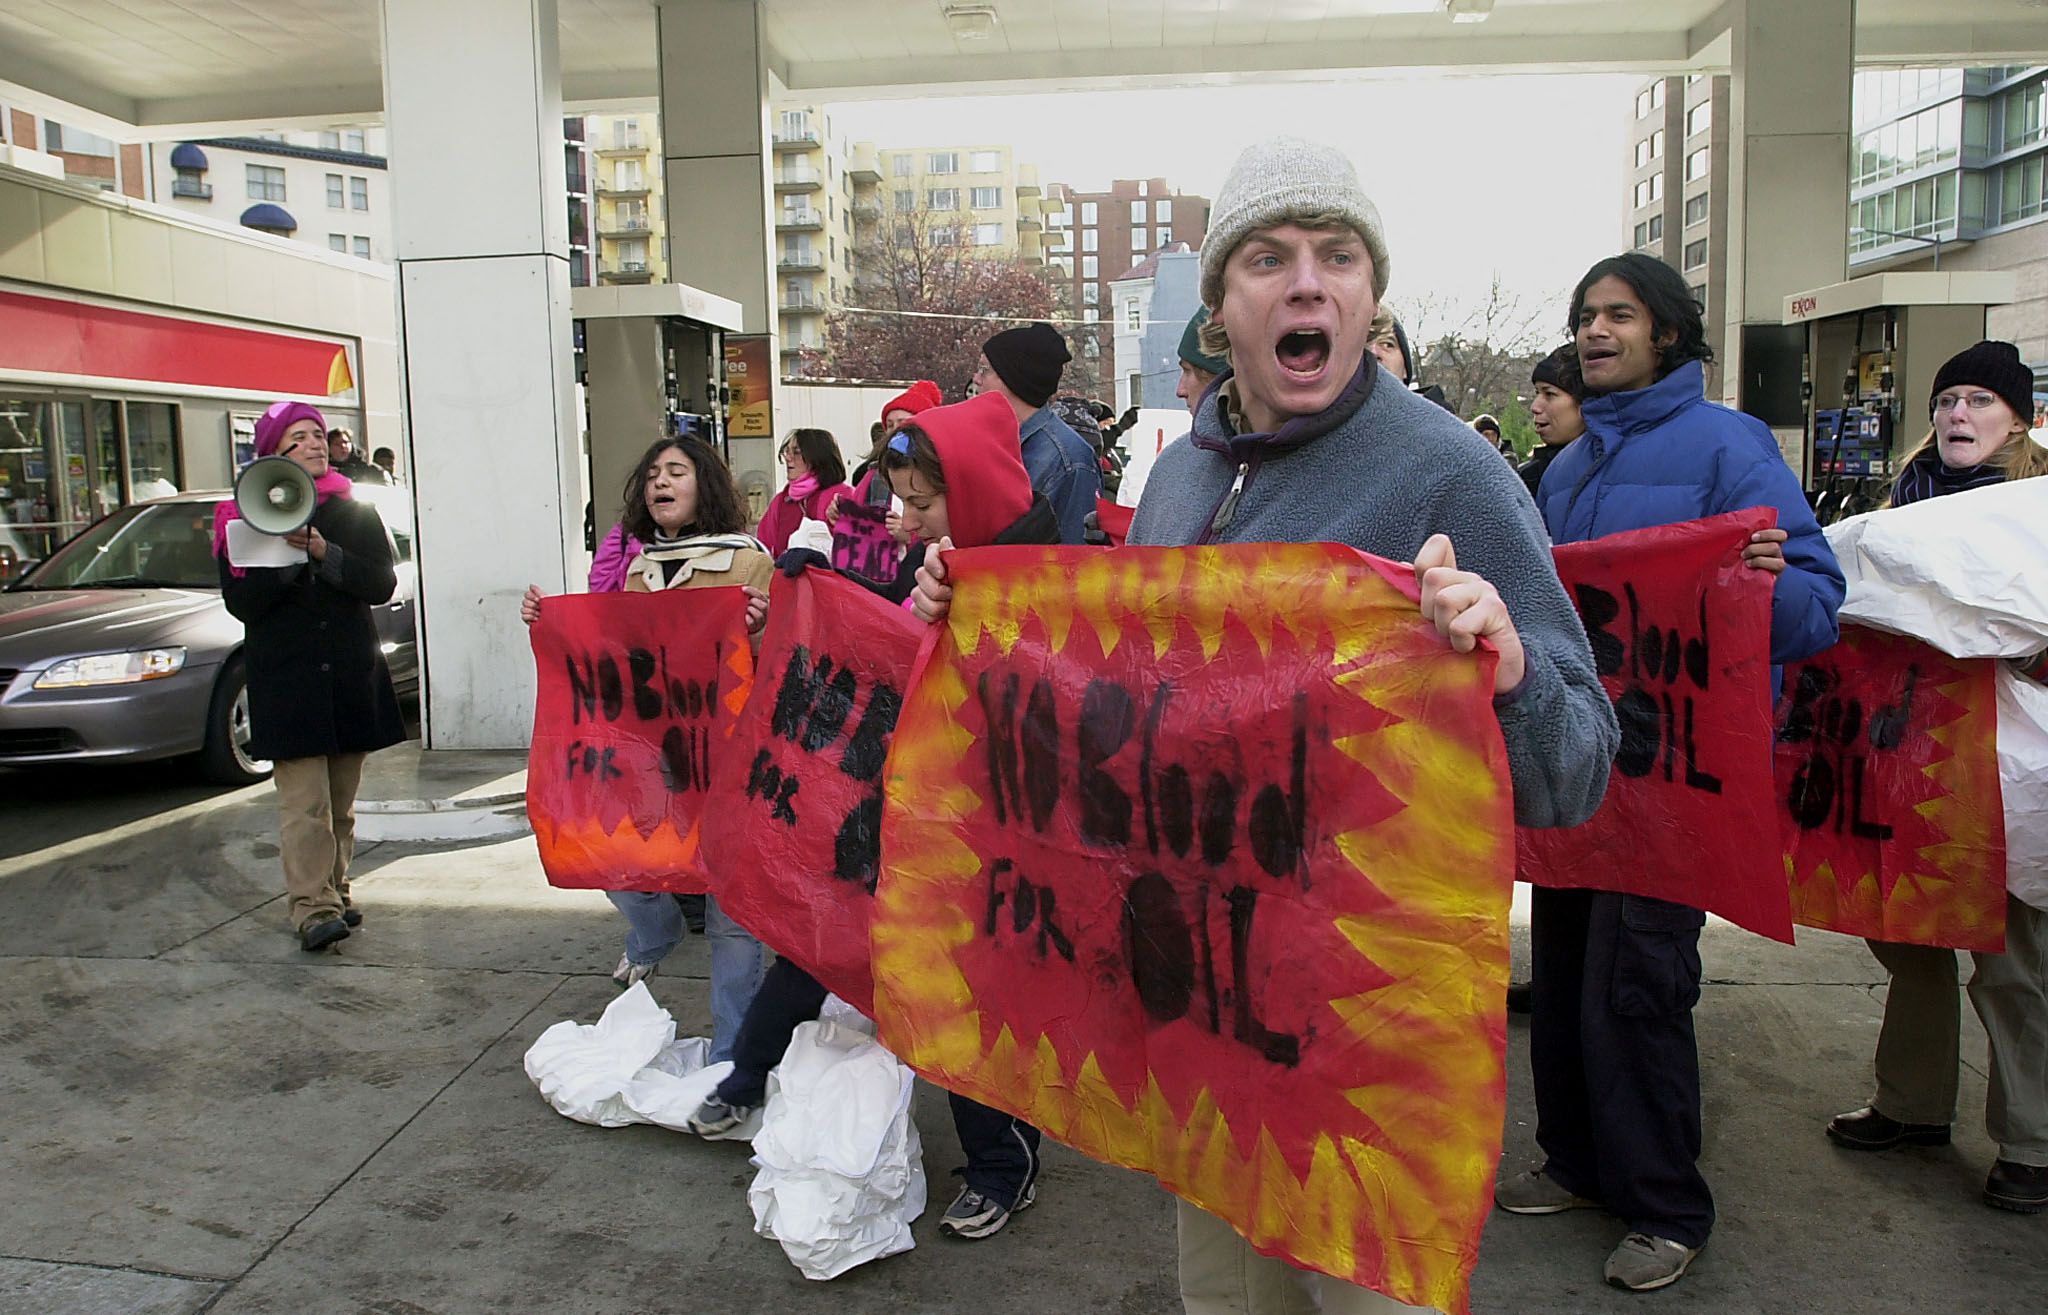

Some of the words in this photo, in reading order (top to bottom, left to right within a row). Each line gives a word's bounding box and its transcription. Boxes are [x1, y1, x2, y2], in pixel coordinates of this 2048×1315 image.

[1791, 296, 1817, 318] EXXON
[565, 647, 624, 725] NO
[628, 641, 722, 721] Blood
[1574, 582, 1710, 691] Blood
[566, 739, 623, 781] FOR
[976, 670, 1060, 833] NO
[1078, 676, 1311, 891] Blood
[1613, 685, 1723, 795] OIL
[1788, 752, 1895, 841] OIL
[986, 856, 1075, 962] FOR
[1119, 872, 1301, 1068] OIL
